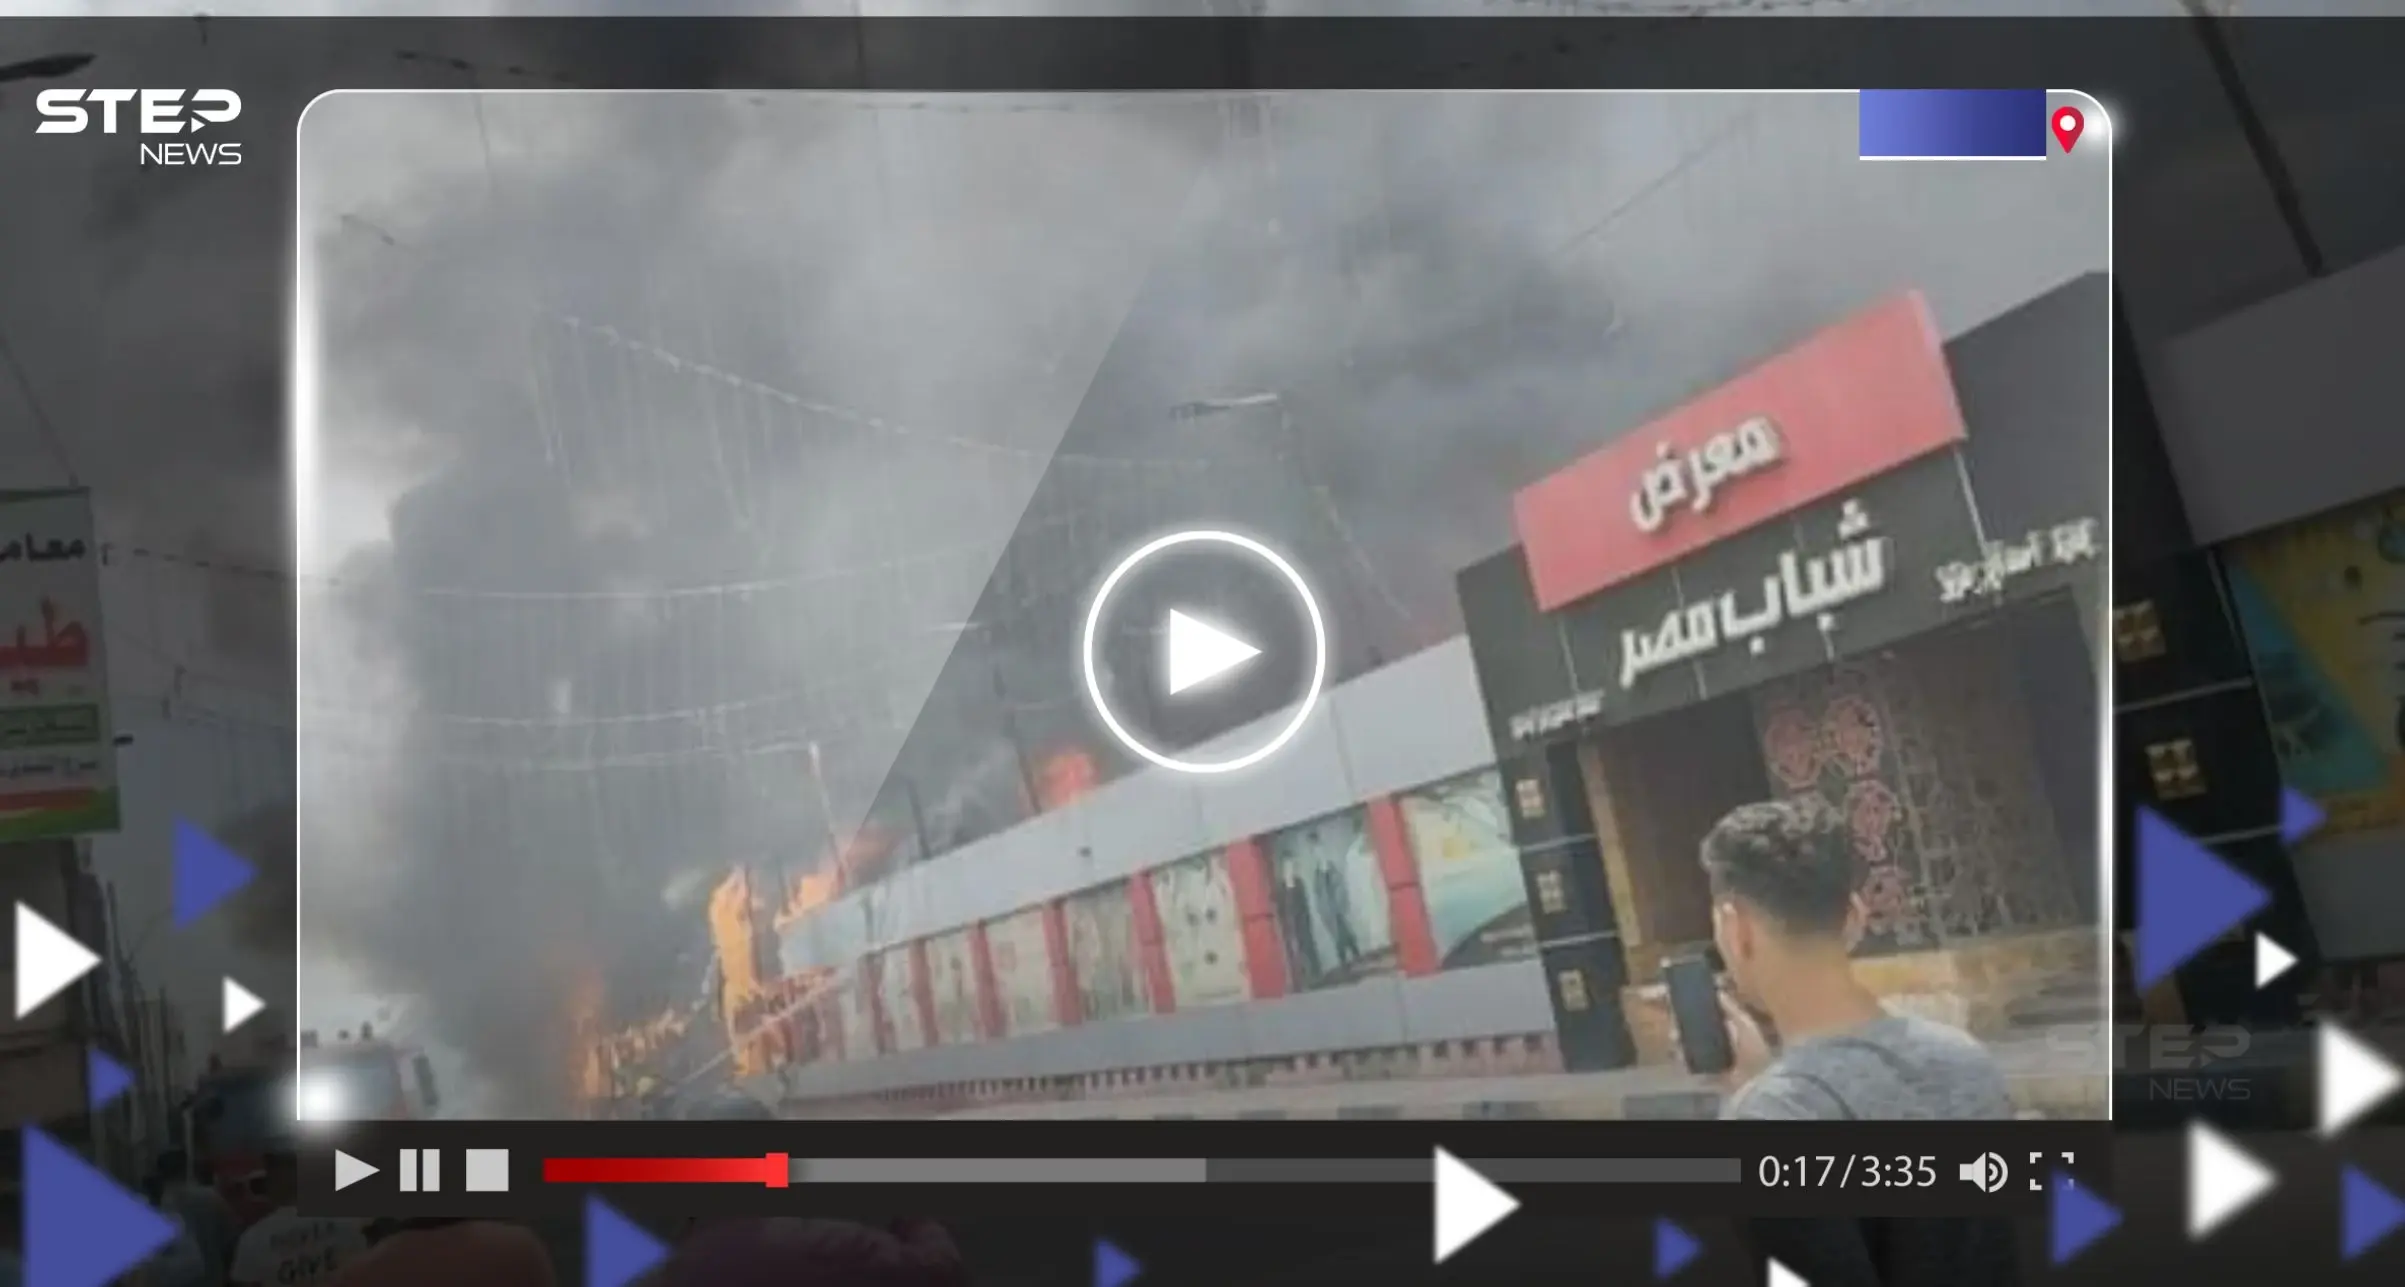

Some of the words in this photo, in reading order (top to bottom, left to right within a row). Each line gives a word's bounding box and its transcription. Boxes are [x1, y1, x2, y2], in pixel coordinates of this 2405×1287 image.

[1630, 416, 1780, 532] معرض
[1719, 498, 1885, 655] شباب
[1619, 600, 1718, 690] مصر
